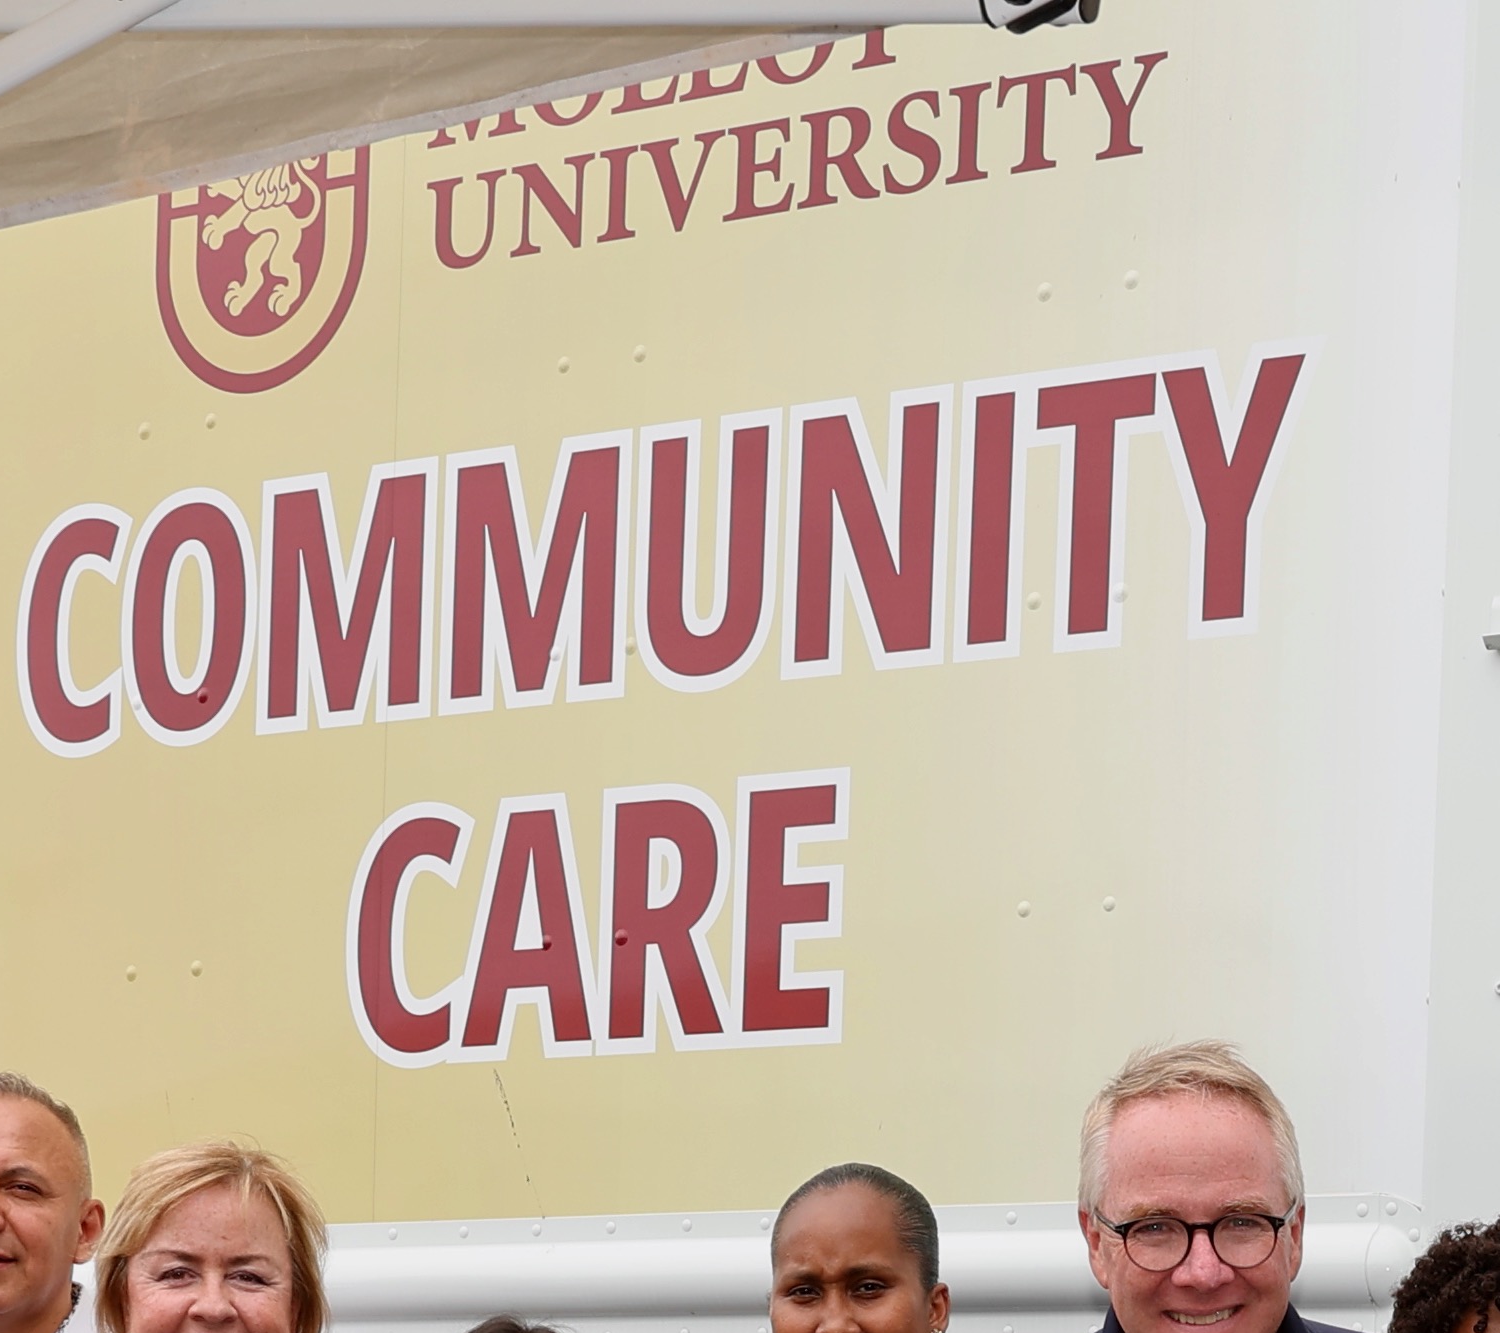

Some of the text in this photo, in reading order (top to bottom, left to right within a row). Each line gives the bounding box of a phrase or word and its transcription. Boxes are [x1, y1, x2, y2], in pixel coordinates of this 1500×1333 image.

[427, 52, 1168, 270] UNIVERSITY
[24, 352, 1308, 744] COMMUNITY
[355, 783, 838, 1056] CARE
